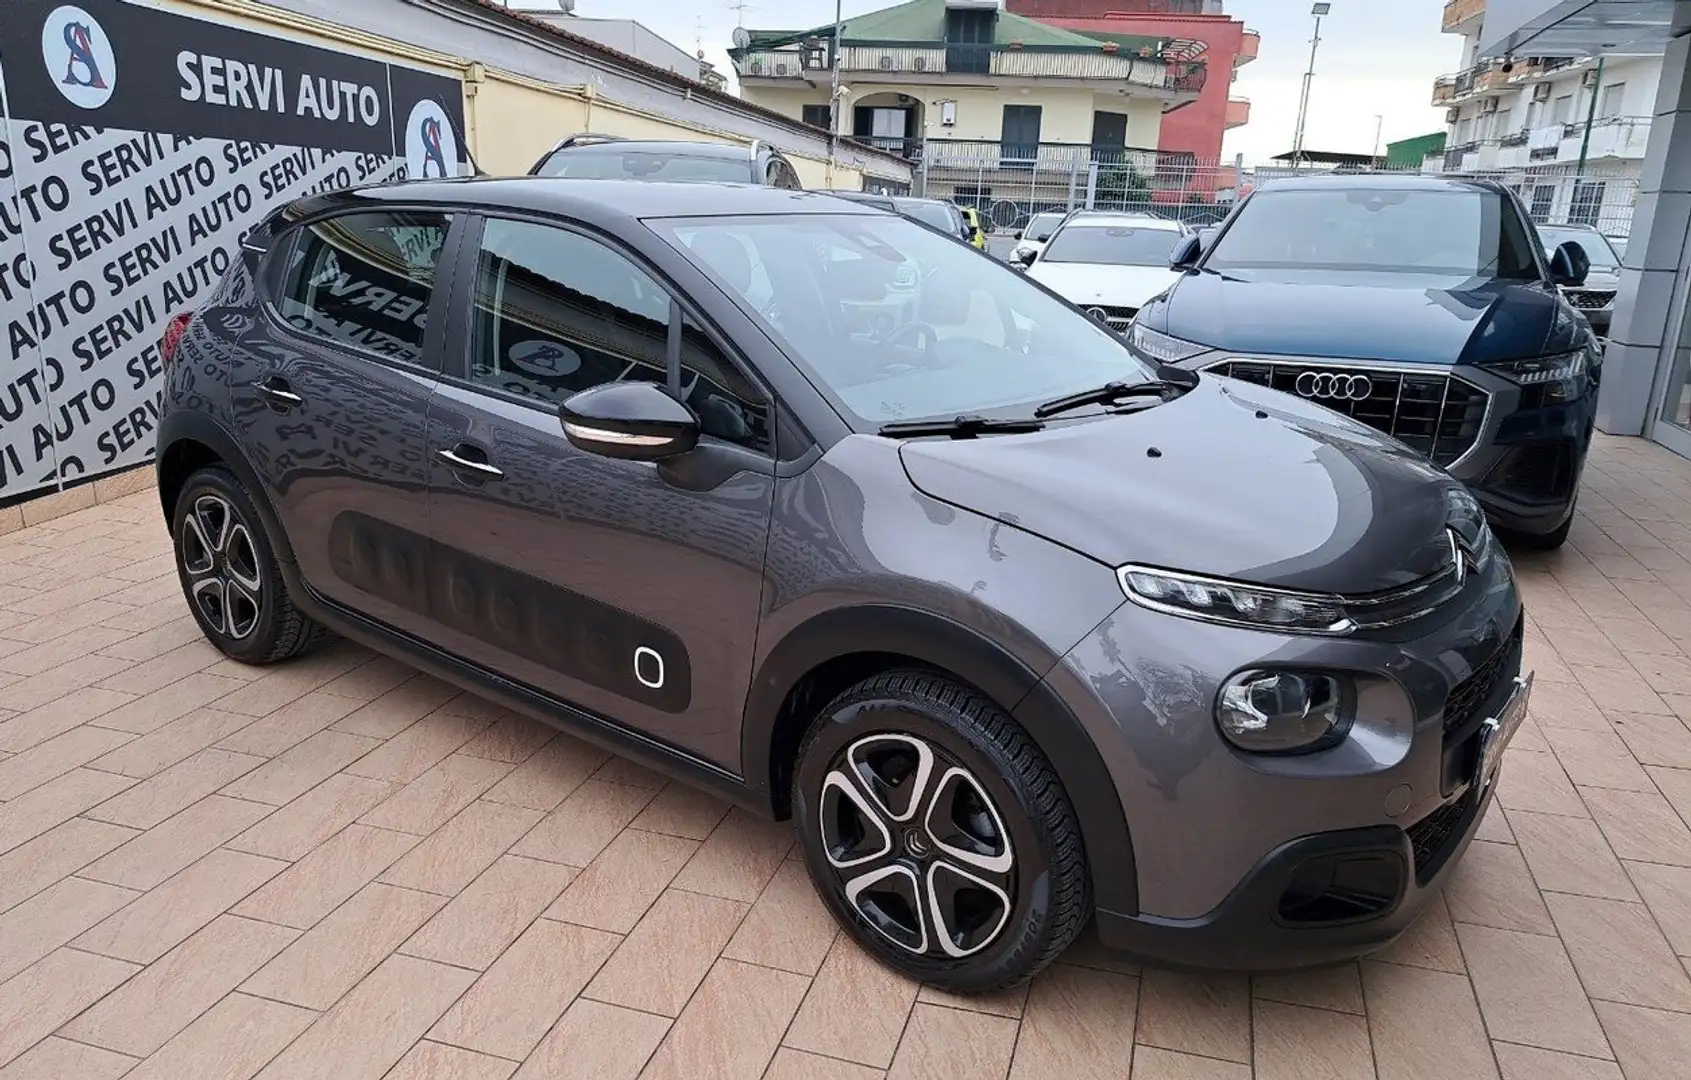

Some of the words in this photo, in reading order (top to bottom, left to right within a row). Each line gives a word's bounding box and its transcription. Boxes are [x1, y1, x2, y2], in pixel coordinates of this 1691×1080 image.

[175, 50, 285, 114] SERVI
[296, 74, 381, 128] AUTO
[48, 197, 138, 271] SERVI
[144, 156, 215, 221] AUTO
[81, 132, 165, 196] SERVI
[8, 279, 96, 360] AUTO
[102, 225, 182, 297] SERVI
[188, 183, 251, 247] AUTO
[259, 146, 316, 200] SERVI
[72, 294, 157, 371] SERVI
[162, 246, 229, 315] AUTO
[32, 377, 116, 462] AUTO
